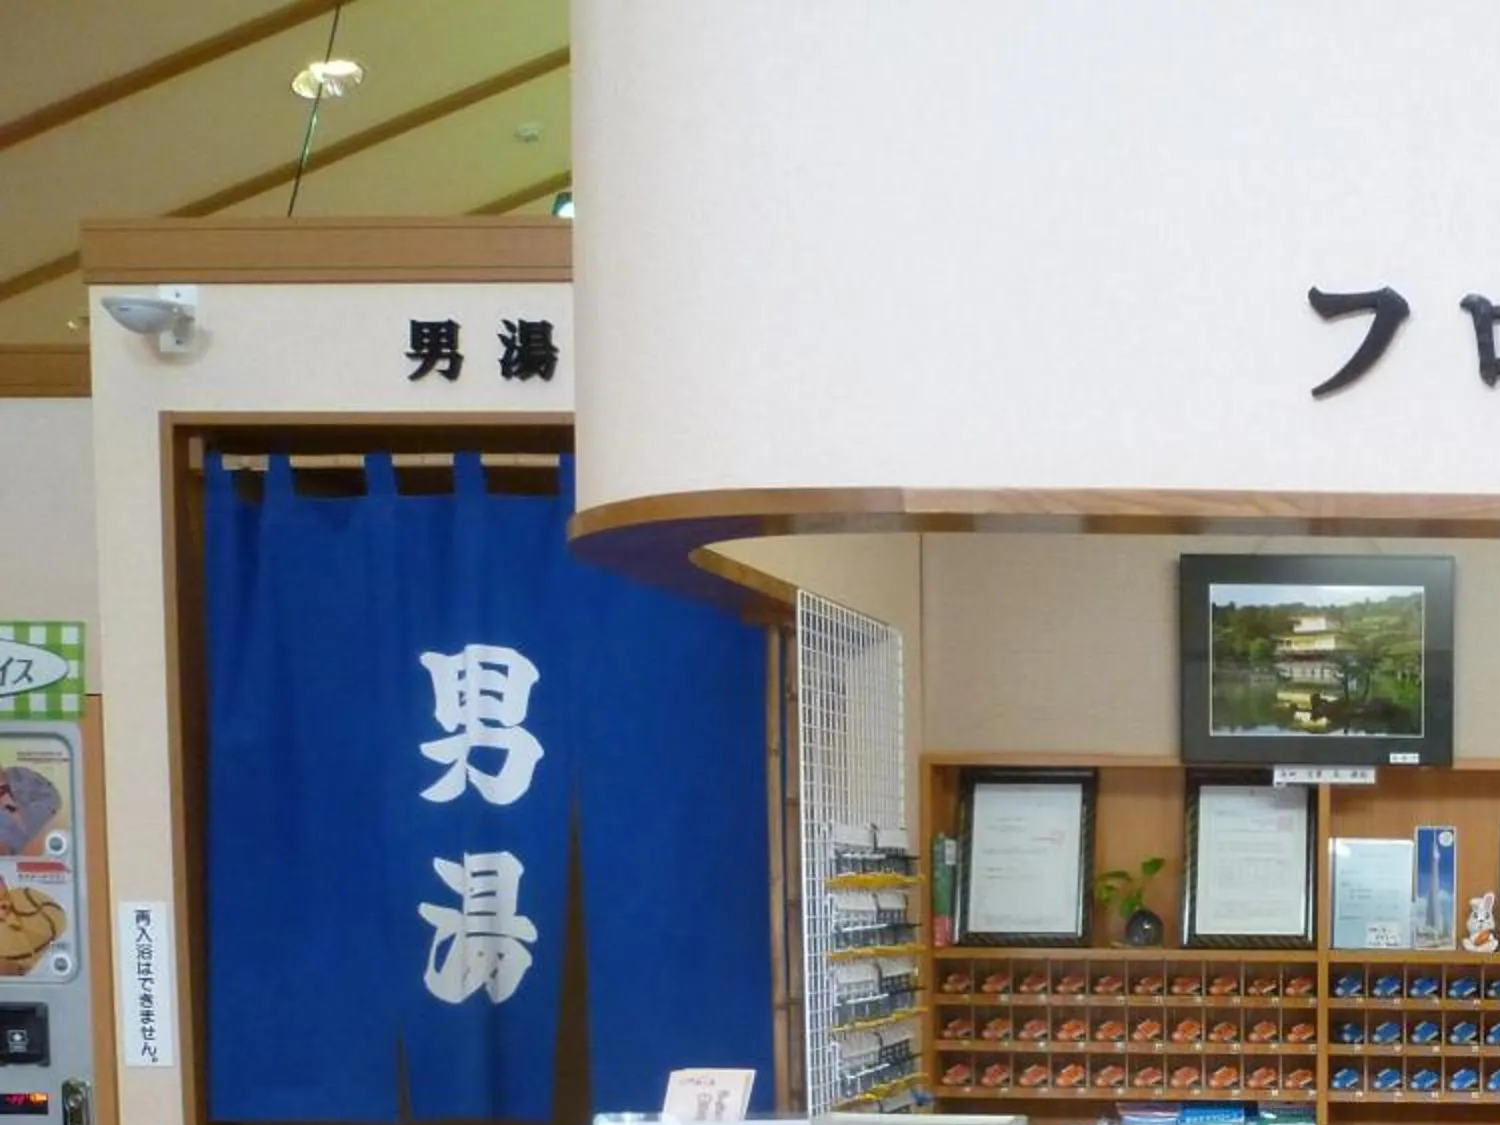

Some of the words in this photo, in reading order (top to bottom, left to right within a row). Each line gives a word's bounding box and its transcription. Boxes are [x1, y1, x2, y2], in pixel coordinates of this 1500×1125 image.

[406, 318, 558, 382] 男湯
[418, 644, 545, 1005] 男湯
[135, 909, 160, 1064] 再入浴はできません。
